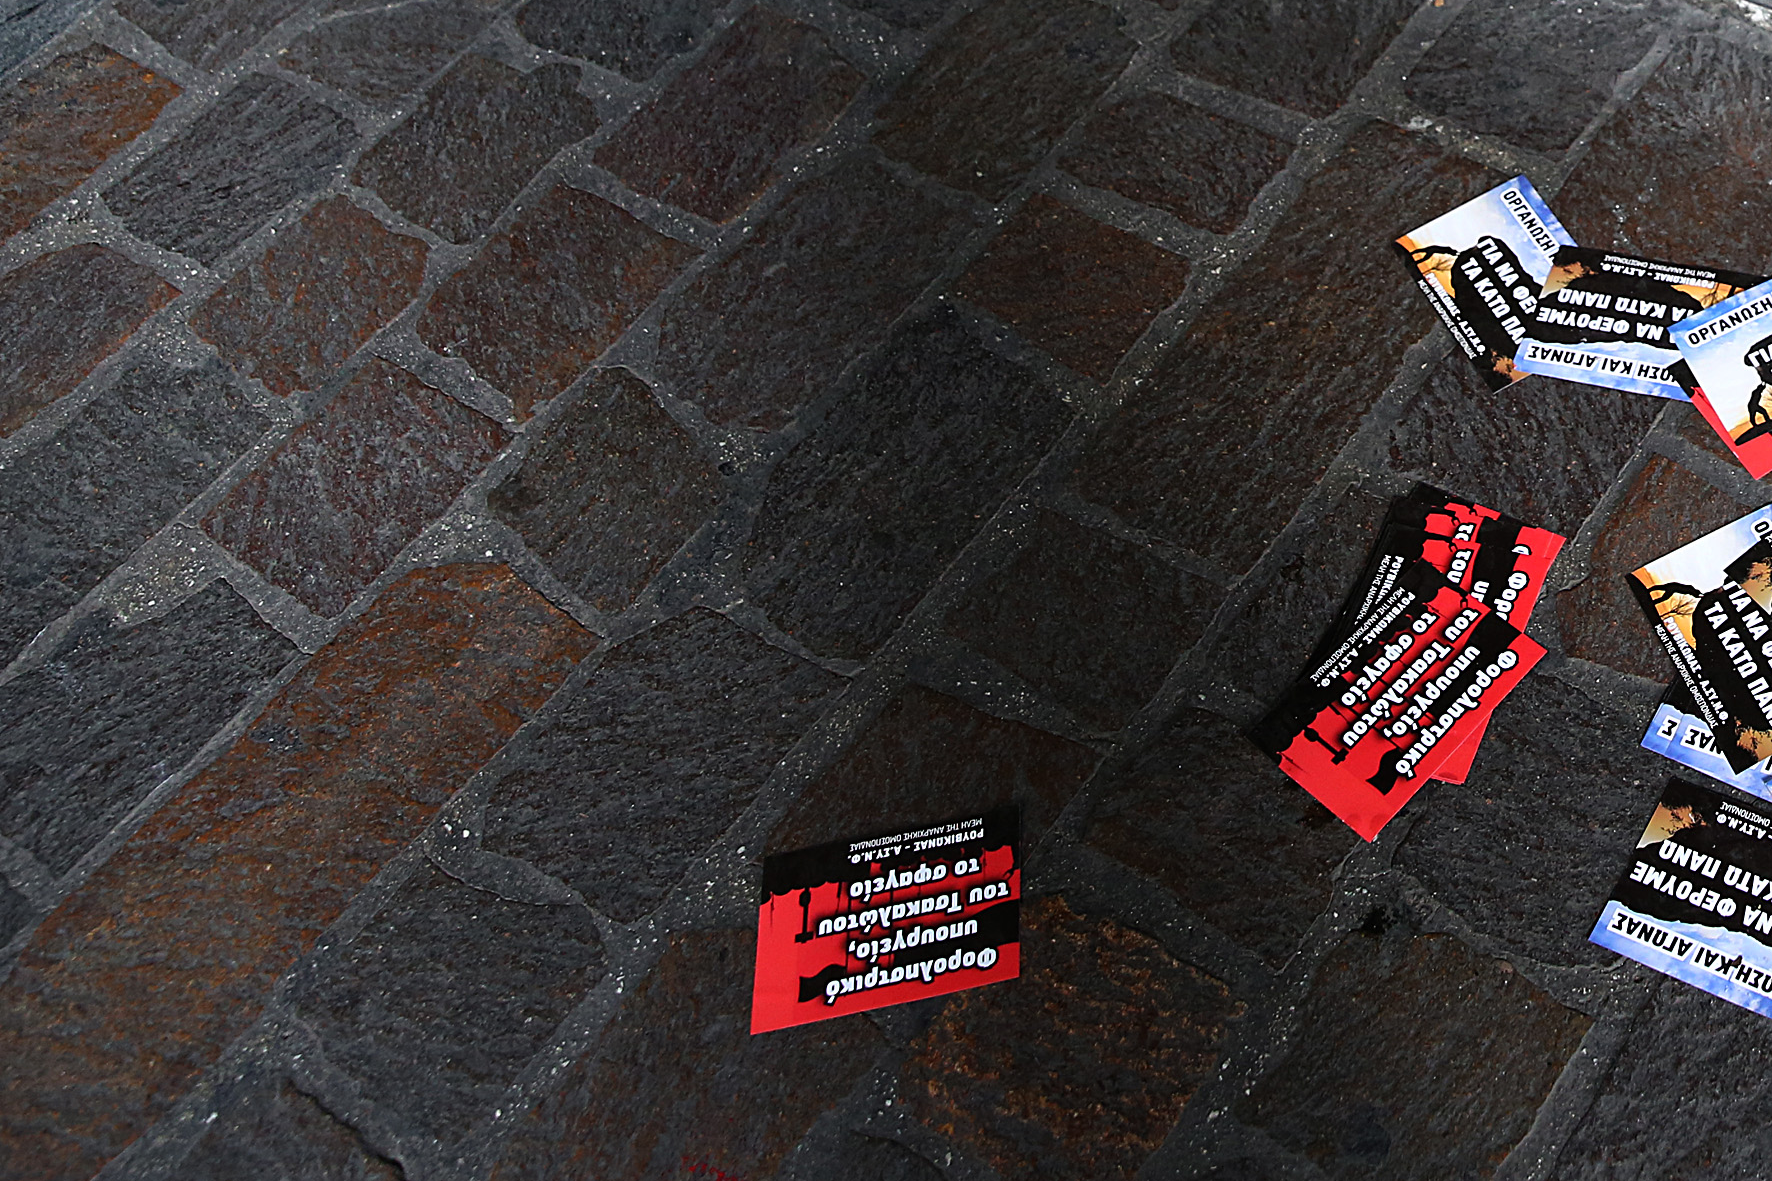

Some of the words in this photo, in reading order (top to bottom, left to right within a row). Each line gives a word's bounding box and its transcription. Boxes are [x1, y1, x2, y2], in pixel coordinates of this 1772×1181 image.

[1503, 190, 1554, 250] ΟΡΓΑΝΩΣΗ
[1476, 237, 1503, 265] ΓΙΑ
[1494, 261, 1519, 287] ΝΑ
[1460, 256, 1482, 280] ΤΑ
[1473, 277, 1510, 318] ΚΑΤΩ
[1556, 287, 1611, 308] ΠΑΝΩ
[1535, 306, 1629, 334] ΦΕΡΟΥΜΕ
[1614, 296, 1666, 318] ΚΑΤΩ
[1688, 297, 1772, 344] ΟΡΓΑΝΩΣΗ
[1636, 322, 1663, 340] ΝΑ
[1528, 345, 1596, 367] ΑΓΩΝΑΣ
[1601, 358, 1632, 374] ΚΑΙ
[1447, 549, 1472, 583] του
[1376, 602, 1390, 615] ΤΗΣ
[1386, 586, 1405, 604] ΜΕΛΗ
[1722, 580, 1751, 612] ΓΙΑ
[1741, 610, 1769, 640] ΝΑ
[1346, 612, 1378, 644] ΑΝΑΡΧΙΚΗΣ
[1362, 591, 1415, 644] ΡΟΥΒΙΚΩΝΑΣ
[1412, 612, 1436, 632] το
[1444, 609, 1478, 640] του
[1663, 616, 1701, 673] ΡΟΥΒΙΚΩΝΑΣ
[1704, 601, 1728, 629] ΤΑ
[1717, 627, 1757, 678] ΚΑΤΩ
[1309, 642, 1350, 681] ΟΜΟΣΠΟΝΔΙΑΣ
[1341, 634, 1412, 705] σφαγείο
[1654, 623, 1669, 642] ΜΕΛΗ
[1664, 640, 1676, 654] ΤΗΣ
[1670, 653, 1694, 687] ΑΝΑΡΧΙΚΗΣ
[1689, 685, 1718, 729] ΟΜΟΣΠΟΝΔΙΑΣ
[1342, 641, 1450, 746] Τσακαλώτου
[1383, 646, 1480, 737] υπουργείο,
[1395, 650, 1516, 777] Φοροληστρικό
[946, 822, 958, 832] ΤΗΣ
[960, 817, 982, 828] ΜΕΛΗ
[1719, 801, 1770, 827] ΟΜΟΣΠΟΝΔΙΑΣ
[849, 834, 901, 852] ΟΜΟΣΠΟΝΔΙΑΣ
[902, 825, 944, 841] ΑΝΑΡΧΙΚΗΣ
[913, 828, 983, 851] ΡΟΥΒΙΚΩΝΑΣ
[954, 858, 979, 874] το
[1658, 837, 1721, 878] ΠΑΝΩ
[850, 864, 946, 901] σφαγείο
[969, 882, 1008, 903] του
[1629, 860, 1736, 916] ΦΕΡΟΥΜΕ
[818, 892, 961, 935] Τσακαλώτου
[848, 919, 977, 962] υπουργείο,
[1611, 912, 1692, 956] ΑΓΩΝΑΣ
[826, 947, 996, 1003] Φοροληστρικό
[1694, 946, 1733, 974] ΚΑΙ
